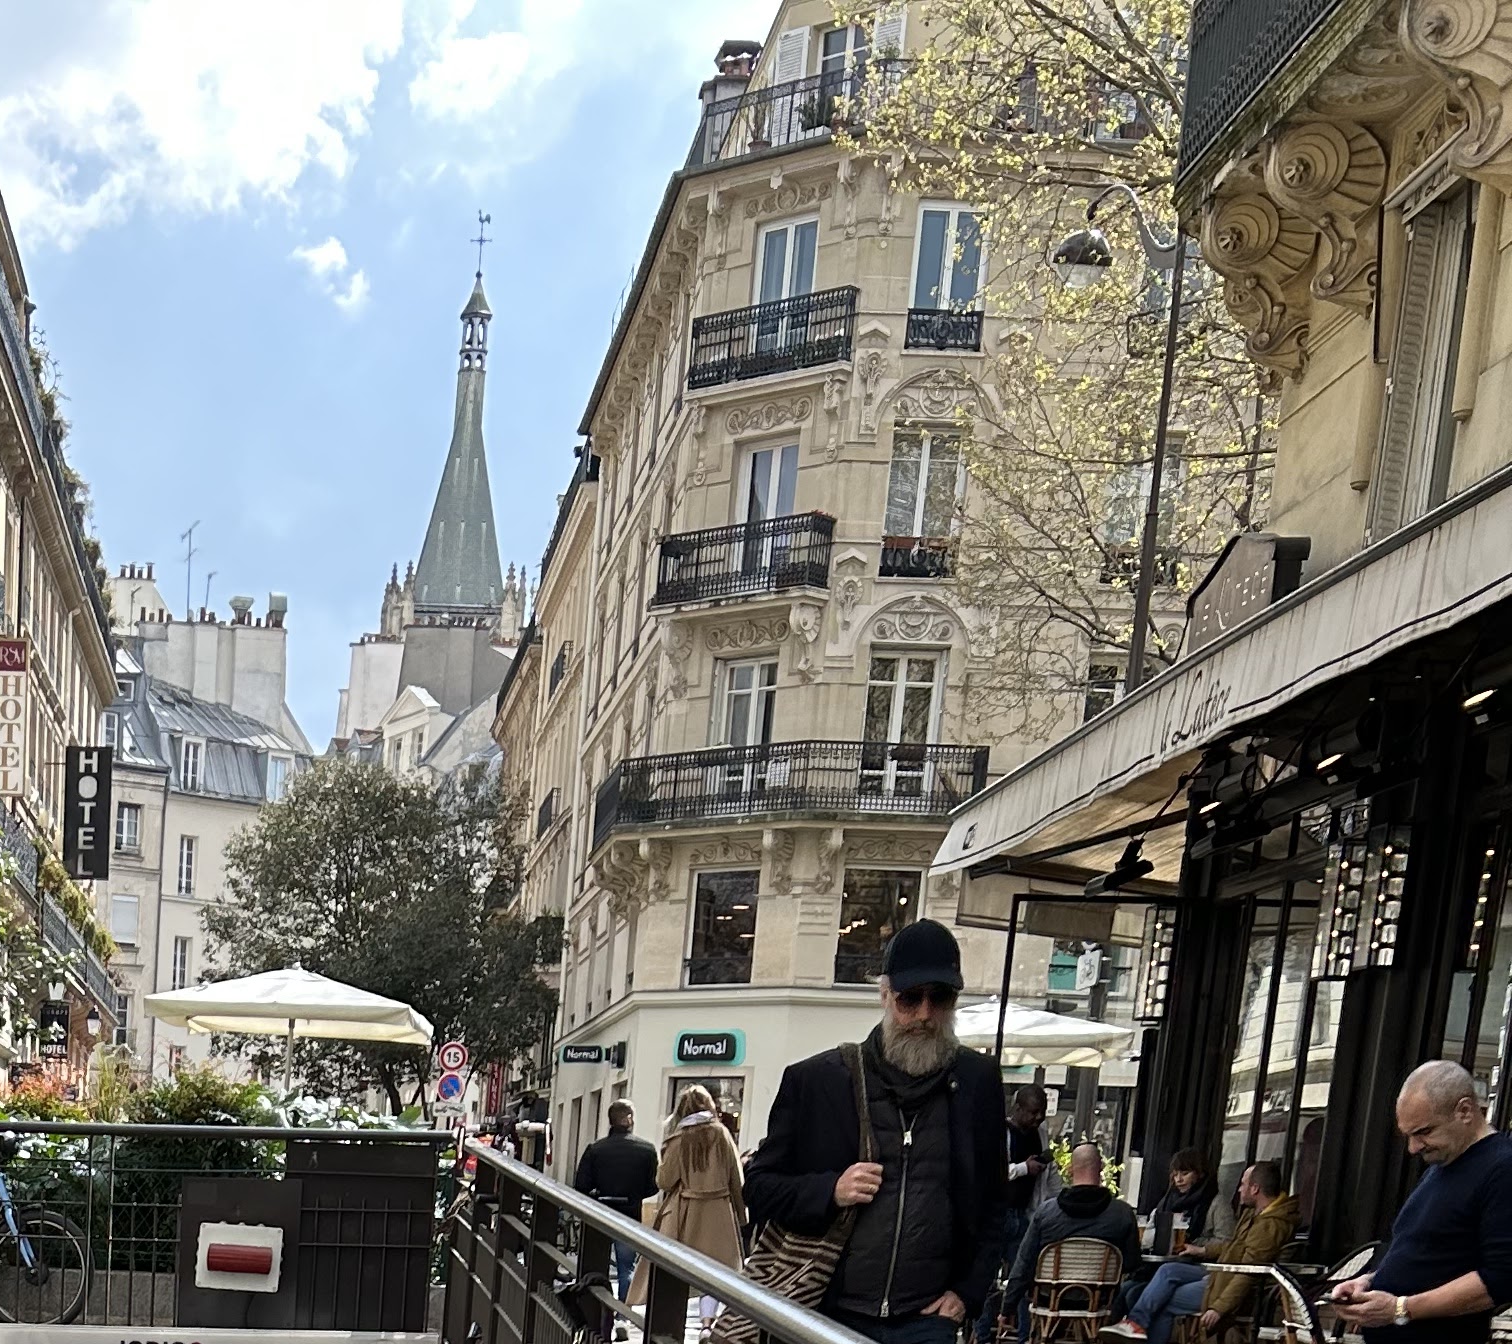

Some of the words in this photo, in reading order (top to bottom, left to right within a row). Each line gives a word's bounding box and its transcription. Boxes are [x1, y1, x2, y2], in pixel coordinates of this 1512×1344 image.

[0, 675, 24, 792] HOTEL
[76, 751, 99, 876] HOTEL
[41, 1045, 68, 1055] HOTEL
[567, 1048, 599, 1060] Normal
[682, 1038, 727, 1056] Normal
[446, 1051, 460, 1064] 15
